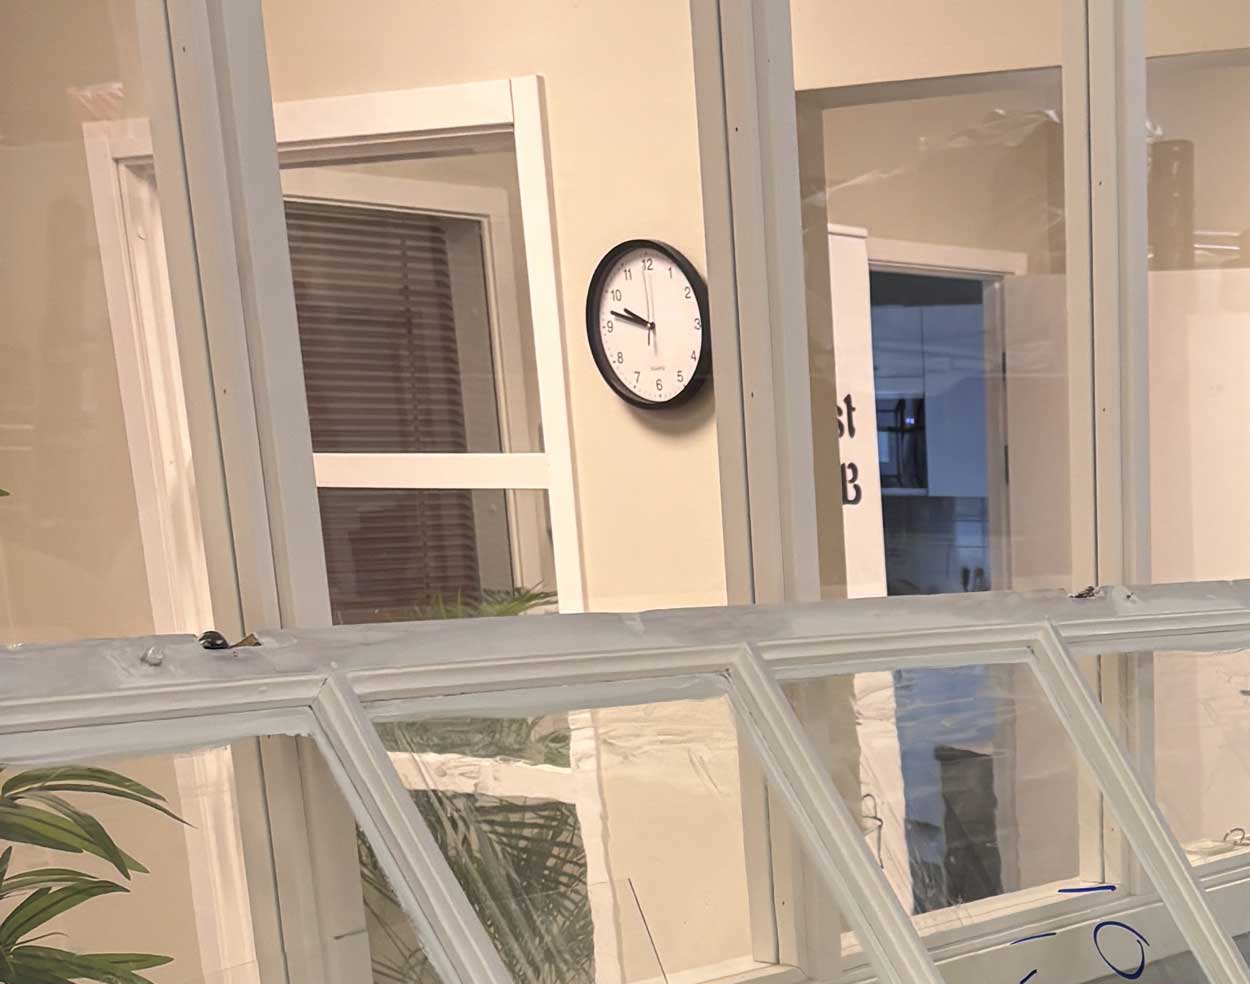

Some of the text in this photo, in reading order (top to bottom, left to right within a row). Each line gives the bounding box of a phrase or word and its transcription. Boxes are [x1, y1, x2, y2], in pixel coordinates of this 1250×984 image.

[641, 258, 654, 271] 12
[623, 268, 633, 281] 11
[611, 289, 622, 302] 10
[684, 286, 692, 299] 2
[606, 320, 614, 333] 9
[694, 318, 702, 330] 3
[617, 352, 624, 364] 8
[690, 350, 697, 361] 4
[634, 371, 641, 384] 7
[677, 370, 684, 383] 5
[656, 379, 663, 391] 6
